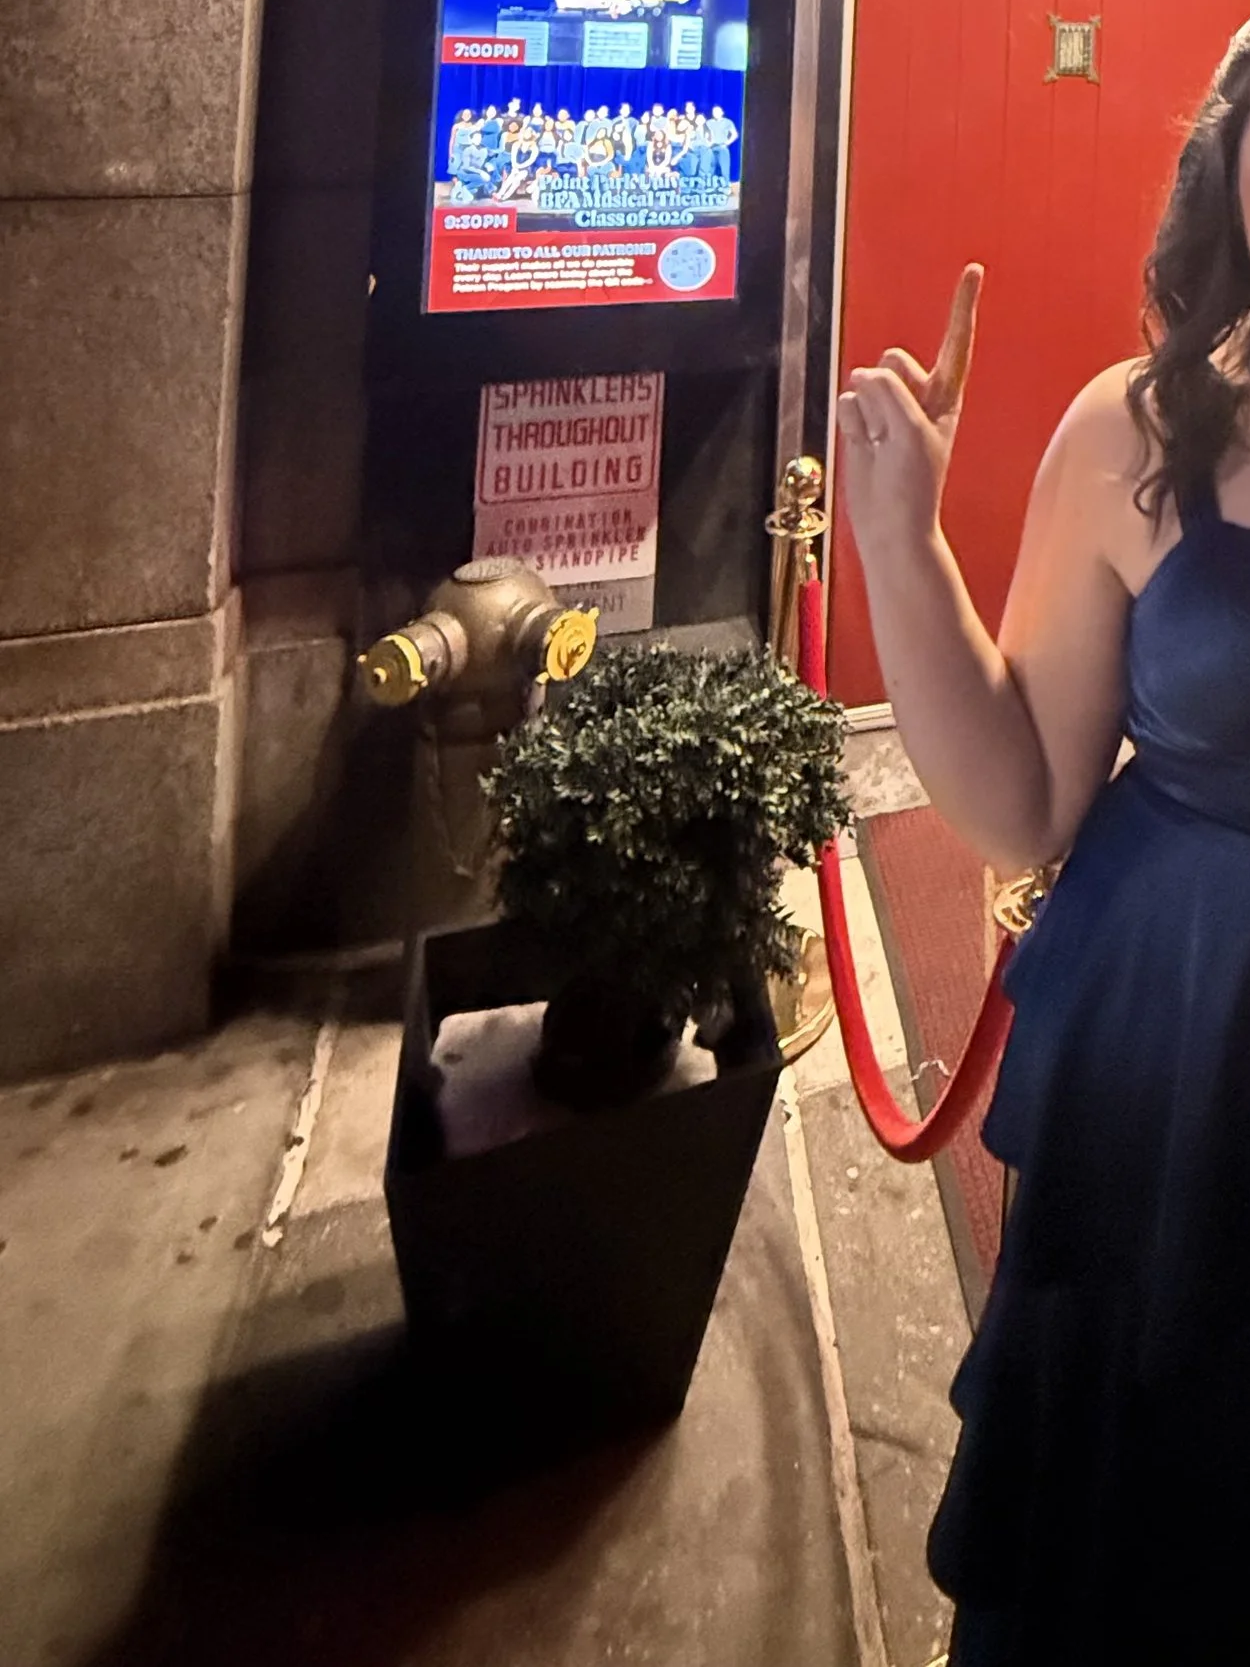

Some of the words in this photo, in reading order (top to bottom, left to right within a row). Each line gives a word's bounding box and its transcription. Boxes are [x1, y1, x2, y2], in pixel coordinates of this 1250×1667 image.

[539, 173, 590, 191] Point
[592, 173, 638, 191] Park
[540, 191, 580, 209] BFA
[582, 190, 653, 209] Musical
[655, 190, 728, 207] Theatre
[574, 210, 625, 228] Class
[626, 209, 648, 226] of
[646, 210, 695, 226] 2026
[512, 246, 532, 259] TO
[533, 245, 560, 258] ALL
[562, 244, 591, 258] OUR
[494, 375, 652, 410] SPRINKLERS
[493, 414, 649, 452] THROUGHOUT
[494, 455, 642, 495] BUILDING
[486, 537, 533, 557] AUTO
[536, 544, 640, 571] STANDPIPE
